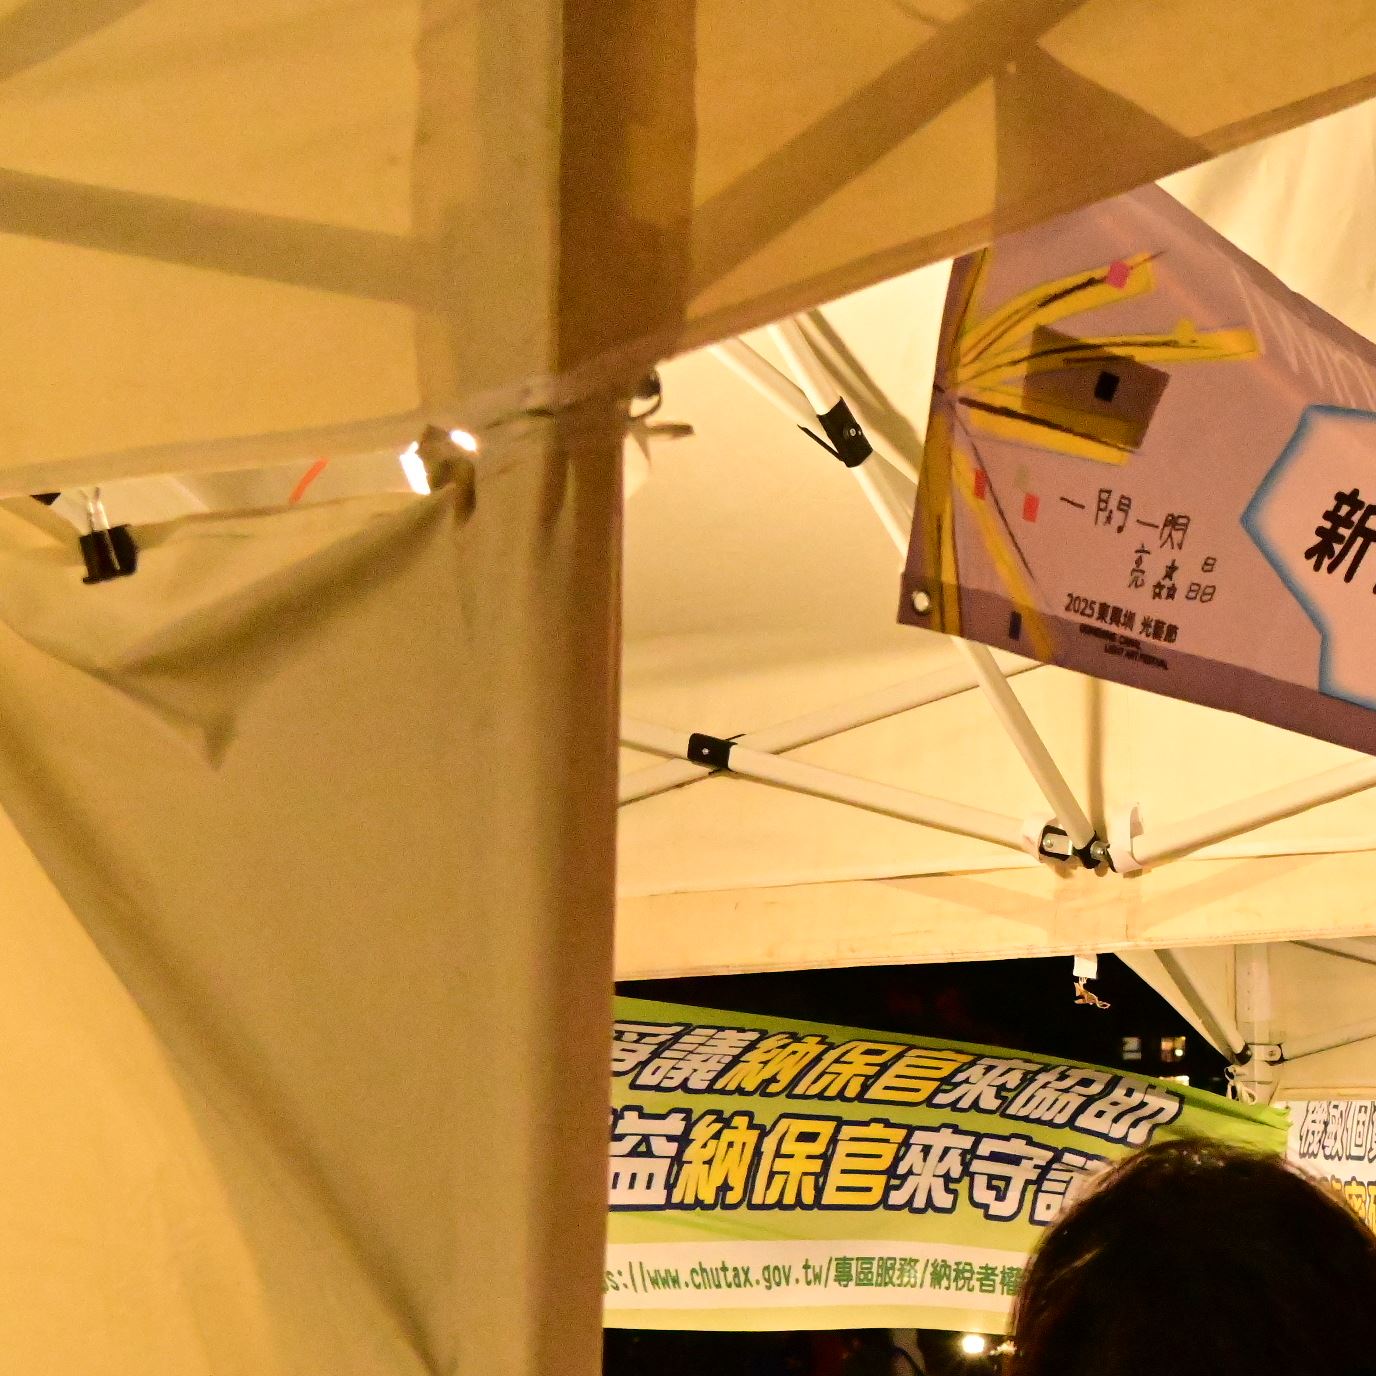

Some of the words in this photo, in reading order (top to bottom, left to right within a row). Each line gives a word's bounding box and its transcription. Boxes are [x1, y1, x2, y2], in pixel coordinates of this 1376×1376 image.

[608, 1104, 1118, 1226] 益納保官來守
[600, 1256, 1023, 1297] s://www.chutax.gov.tw/專區服務/納稅者權
